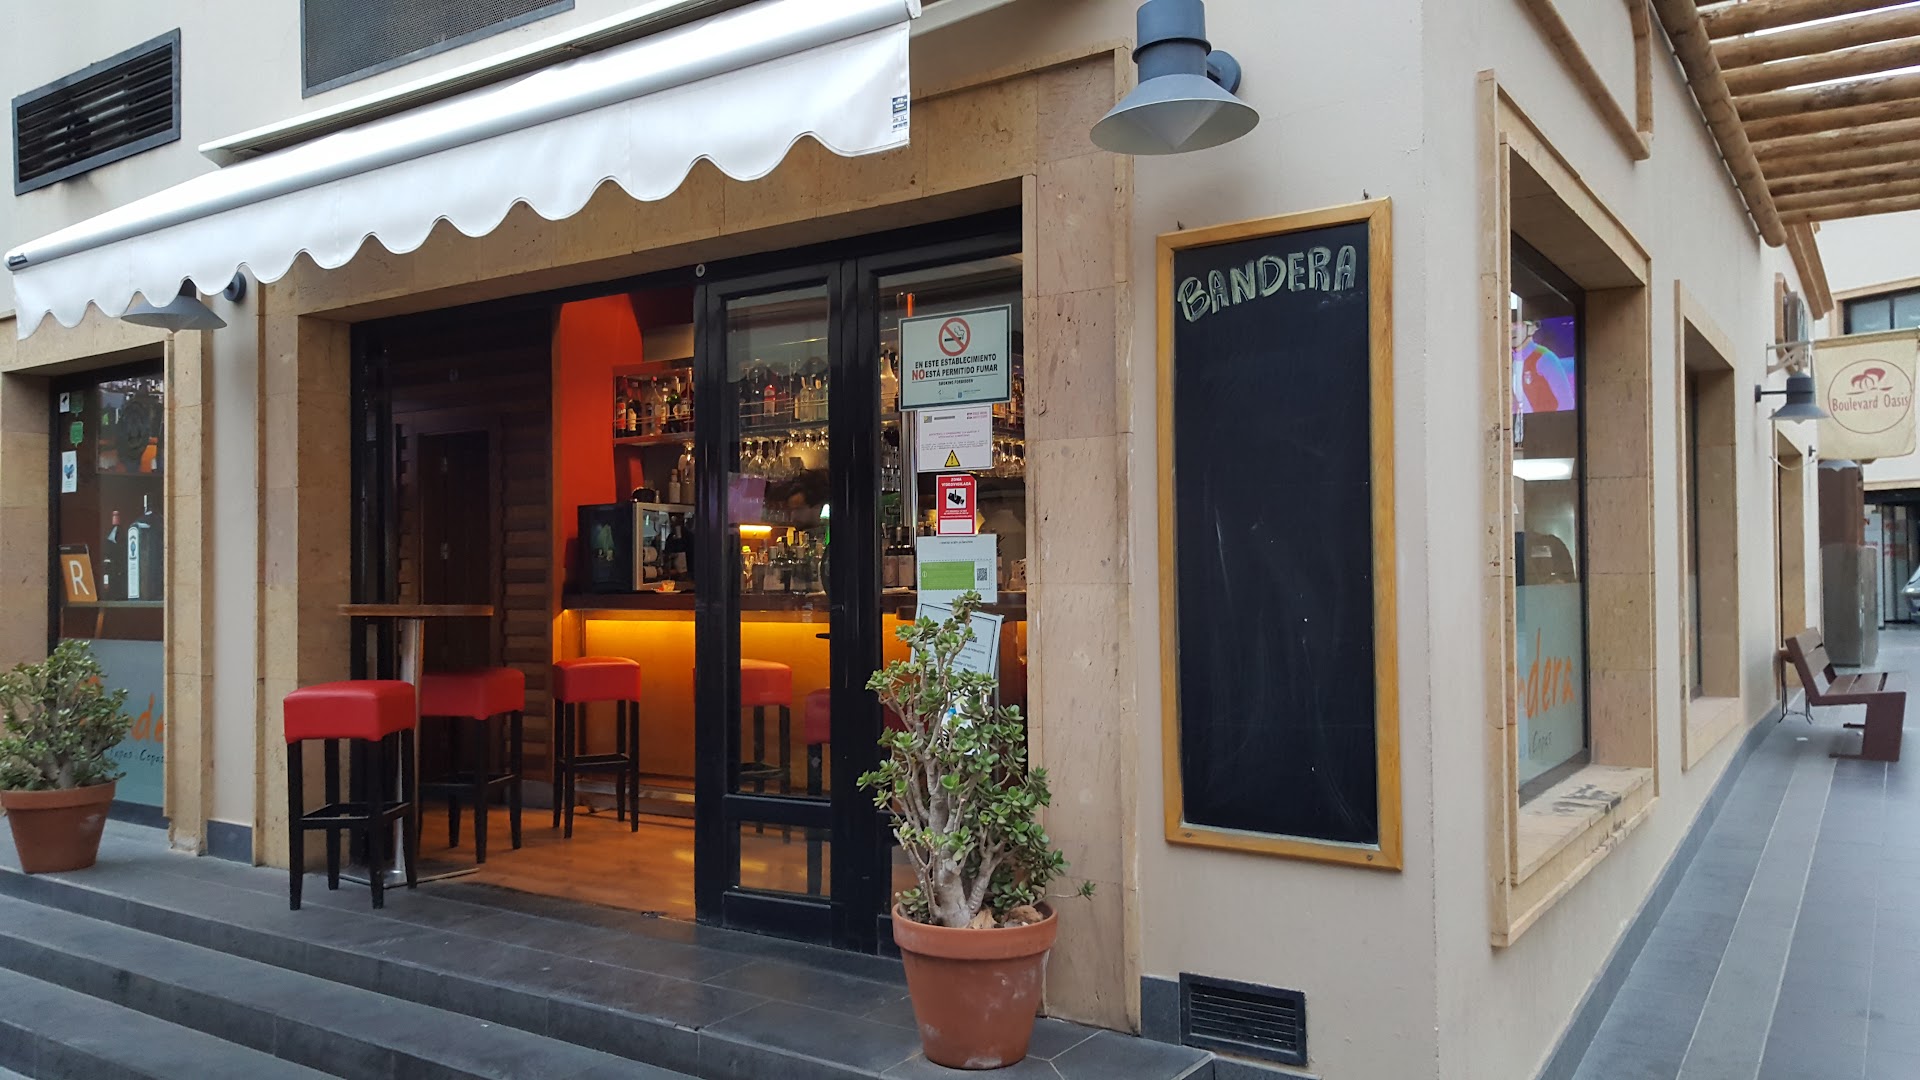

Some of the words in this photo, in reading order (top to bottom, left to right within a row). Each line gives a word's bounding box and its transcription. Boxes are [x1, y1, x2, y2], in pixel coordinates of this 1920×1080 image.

[1177, 245, 1357, 323] BANDERA
[915, 361, 923, 369] EN
[925, 359, 939, 368] ESTE
[941, 353, 997, 366] ESTABLECIMIENTO
[912, 369, 925, 381] NO
[942, 366, 974, 377] PERMITIDO
[976, 364, 998, 373] FUMAR
[1832, 395, 1878, 412] Boulevard
[1884, 393, 1909, 408] Oasis
[69, 560, 90, 596] R
